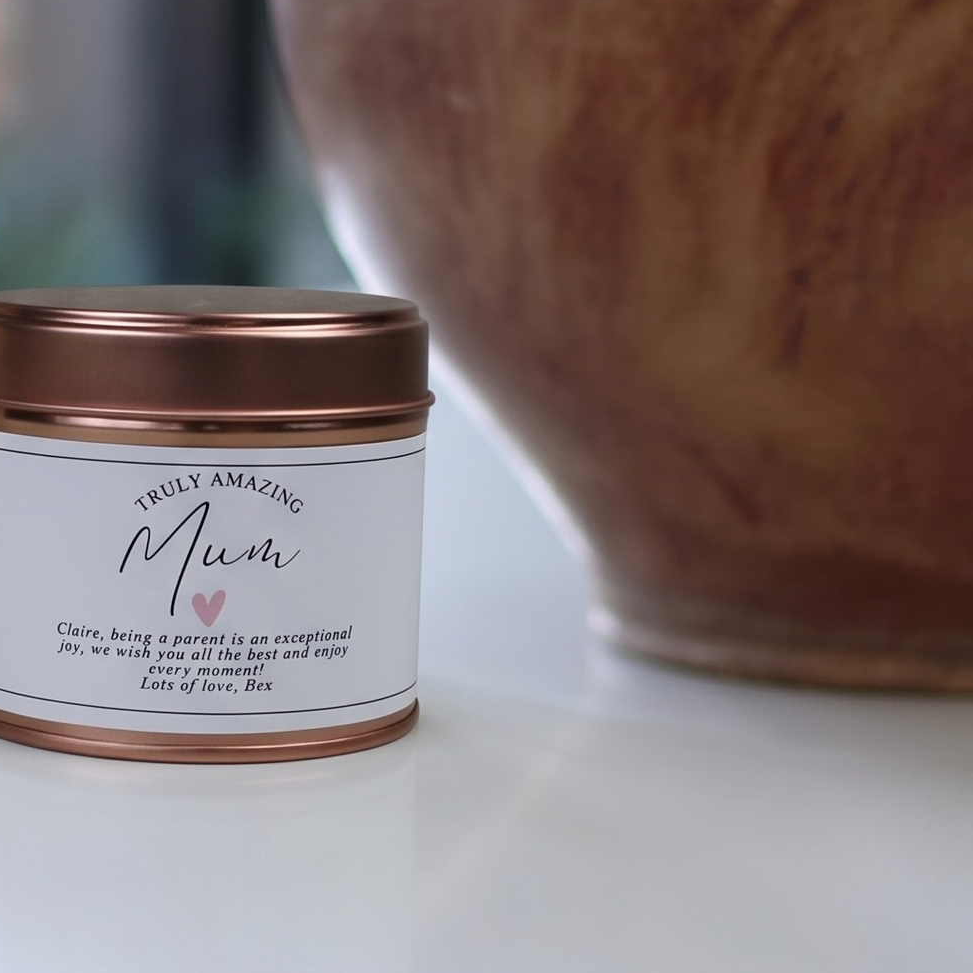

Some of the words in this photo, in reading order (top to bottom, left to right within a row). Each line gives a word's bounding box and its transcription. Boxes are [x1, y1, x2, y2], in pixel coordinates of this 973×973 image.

[133, 472, 202, 513] TRULY
[209, 471, 305, 514] AMAZING
[118, 500, 301, 617] Mum
[56, 621, 105, 642] Claire,
[110, 627, 152, 646] being
[158, 634, 168, 645] a
[172, 633, 226, 648] parent
[231, 632, 245, 646] is
[249, 635, 269, 646] an
[273, 625, 353, 646] exceptional
[57, 638, 85, 656] joy,
[90, 645, 111, 656] we
[116, 643, 152, 659] wish
[157, 650, 186, 663] you
[190, 647, 213, 661] all
[217, 647, 242, 662] the
[246, 647, 279, 661] best
[282, 644, 310, 660] and
[313, 643, 350, 661] enjoy
[148, 665, 192, 679] every
[196, 662, 266, 677] moment!
[139, 676, 175, 691] Lots
[179, 677, 201, 695] of
[201, 678, 239, 695] love,
[243, 678, 273, 693] Bex
